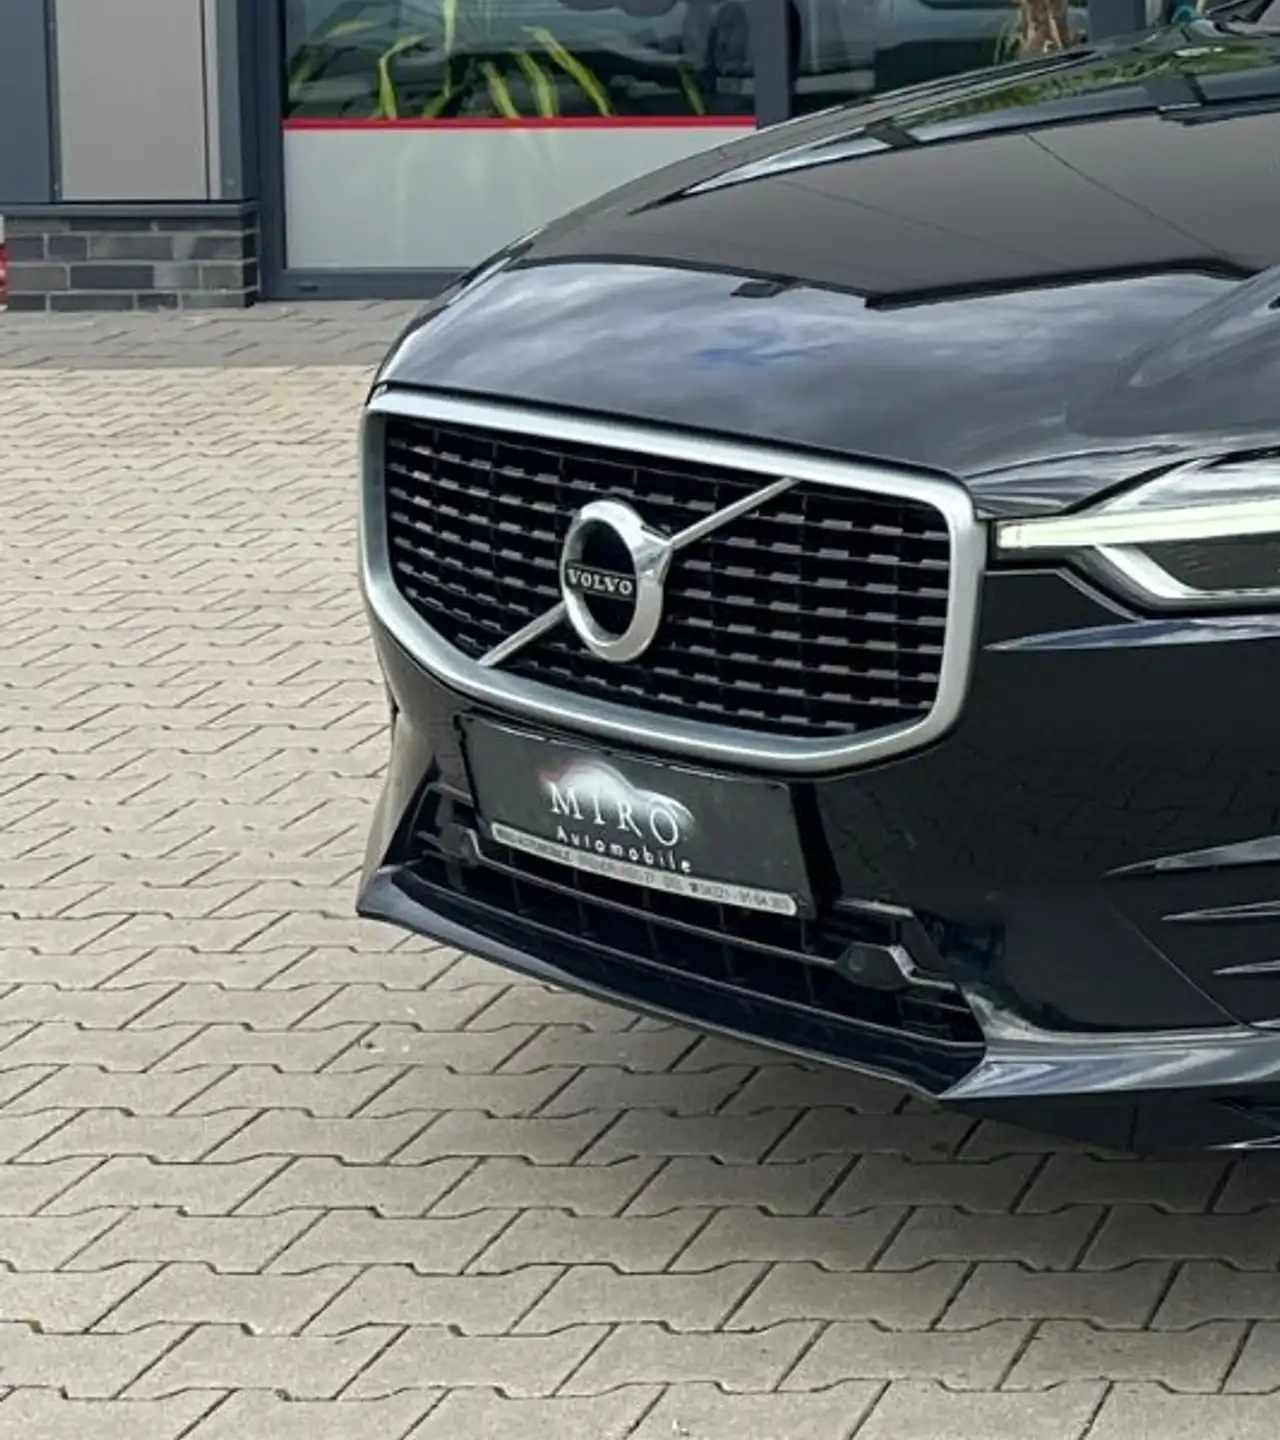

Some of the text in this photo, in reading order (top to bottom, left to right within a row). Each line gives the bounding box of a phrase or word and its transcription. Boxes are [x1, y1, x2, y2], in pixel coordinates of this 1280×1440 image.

[567, 568, 634, 595] VOLVO
[549, 779, 681, 847] MIRO
[555, 825, 693, 874] Automobile
